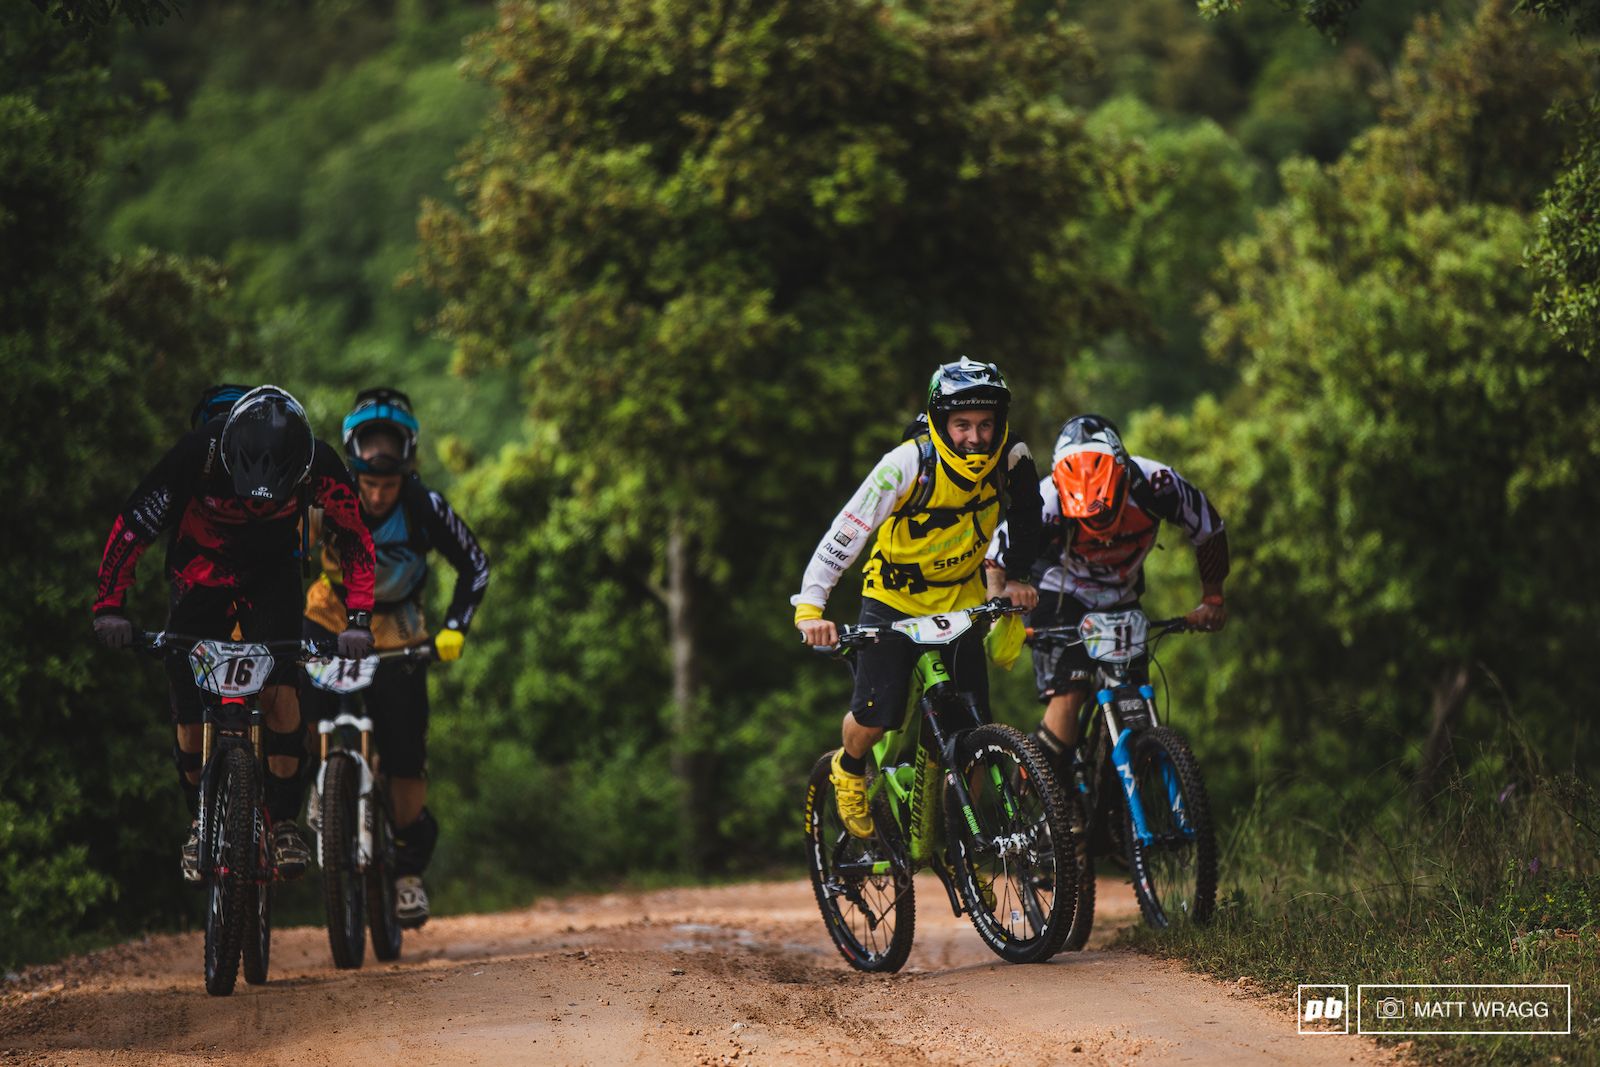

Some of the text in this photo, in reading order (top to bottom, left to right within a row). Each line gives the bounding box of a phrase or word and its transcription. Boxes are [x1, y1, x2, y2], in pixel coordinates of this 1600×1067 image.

[204, 437, 217, 474] ERGON
[251, 489, 273, 499] GIRO
[843, 510, 872, 532] SRAM
[822, 542, 849, 561] Avid
[933, 539, 984, 571] SRAM
[931, 615, 951, 630] 6
[1114, 625, 1132, 651] 11
[224, 658, 255, 687] 16
[338, 659, 360, 683] 14
[805, 784, 816, 835] MAXXIS
